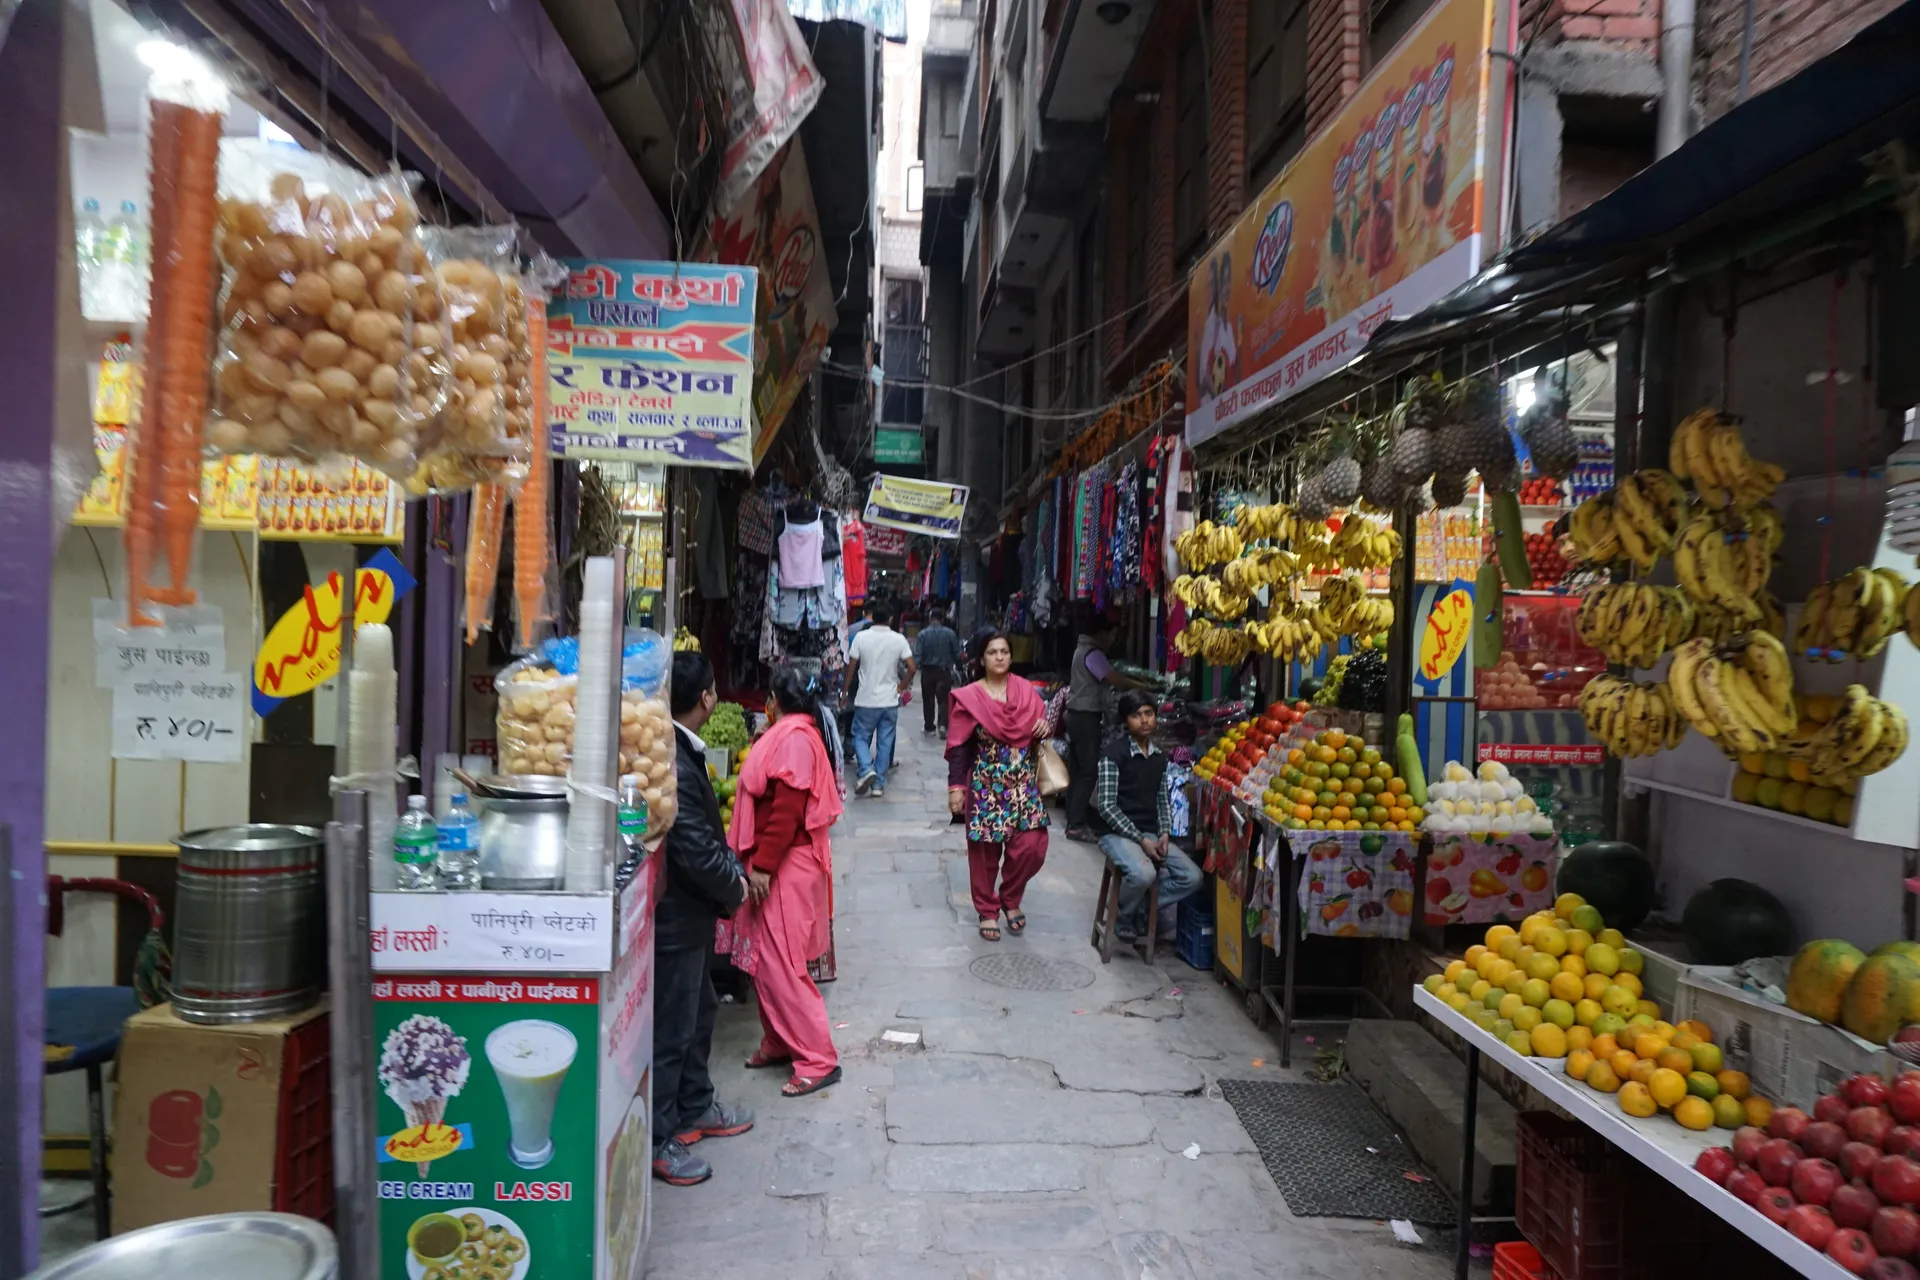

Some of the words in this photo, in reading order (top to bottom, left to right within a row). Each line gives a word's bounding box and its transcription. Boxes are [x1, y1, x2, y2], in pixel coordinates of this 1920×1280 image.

[587, 301, 659, 328] पसल
[543, 911, 598, 932] प्लेटको
[393, 924, 440, 952] लस्सी
[396, 980, 442, 998] लस्सी
[445, 983, 458, 998] र
[408, 1181, 474, 1199] CREAM
[495, 1181, 571, 1200] LASSI
